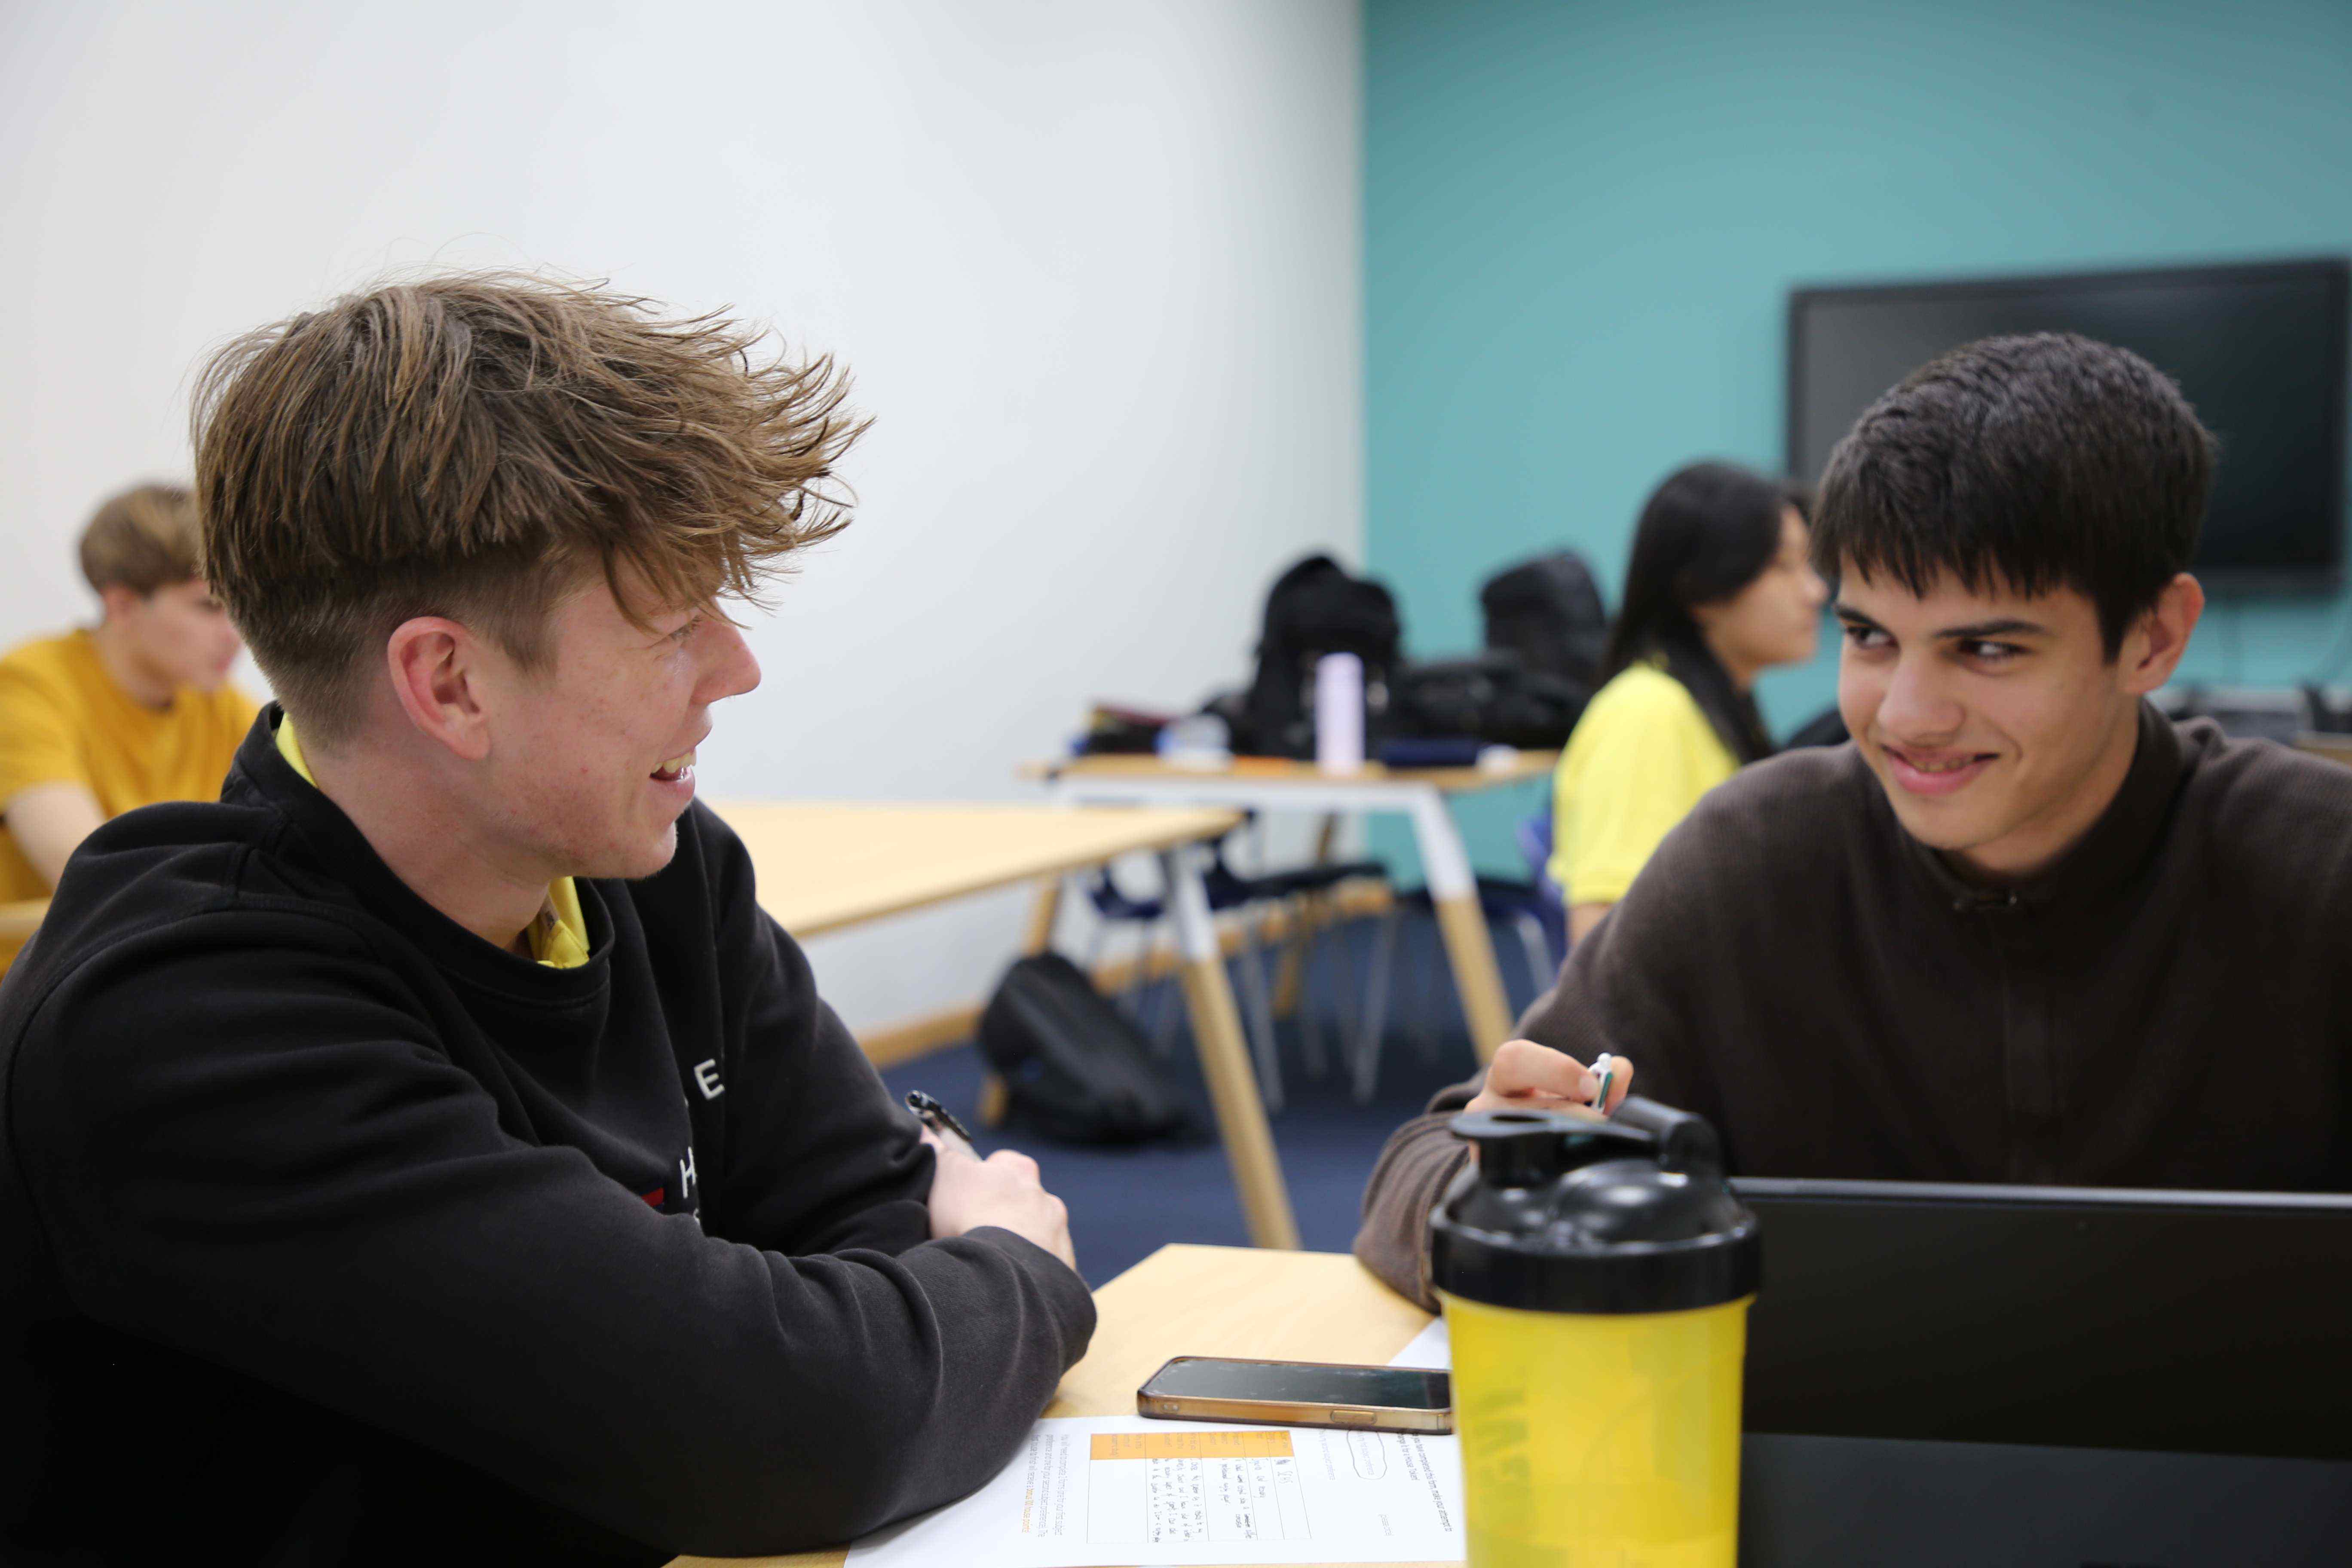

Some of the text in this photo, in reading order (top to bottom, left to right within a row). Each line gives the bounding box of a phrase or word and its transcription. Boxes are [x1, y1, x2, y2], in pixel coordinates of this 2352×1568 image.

[692, 1058, 726, 1100] E
[1043, 1434, 1055, 1452] preference
[1321, 1443, 1329, 1452] second
[1323, 1453, 1332, 1463] subject
[1405, 1456, 1414, 1467] House
[1416, 1453, 1431, 1471] completed
[1057, 1459, 1067, 1475] complete
[1326, 1464, 1335, 1481] preference
[1364, 1459, 1376, 1475] preference
[1026, 1471, 1035, 1484] receive
[1041, 1470, 1050, 1479] your
[1041, 1479, 1050, 1492] second
[1057, 1478, 1067, 1489] forms
[1428, 1479, 1437, 1489] form,
[1025, 1488, 1034, 1500] bonus
[1038, 1492, 1050, 1505] subject
[1432, 1490, 1441, 1500] make
[1054, 1502, 1064, 1512] your
[1433, 1500, 1444, 1509] your
[1023, 1506, 1033, 1518] house
[1055, 1512, 1064, 1520] first
[1438, 1510, 1451, 1527] attempt
[1052, 1520, 1063, 1536] subject
